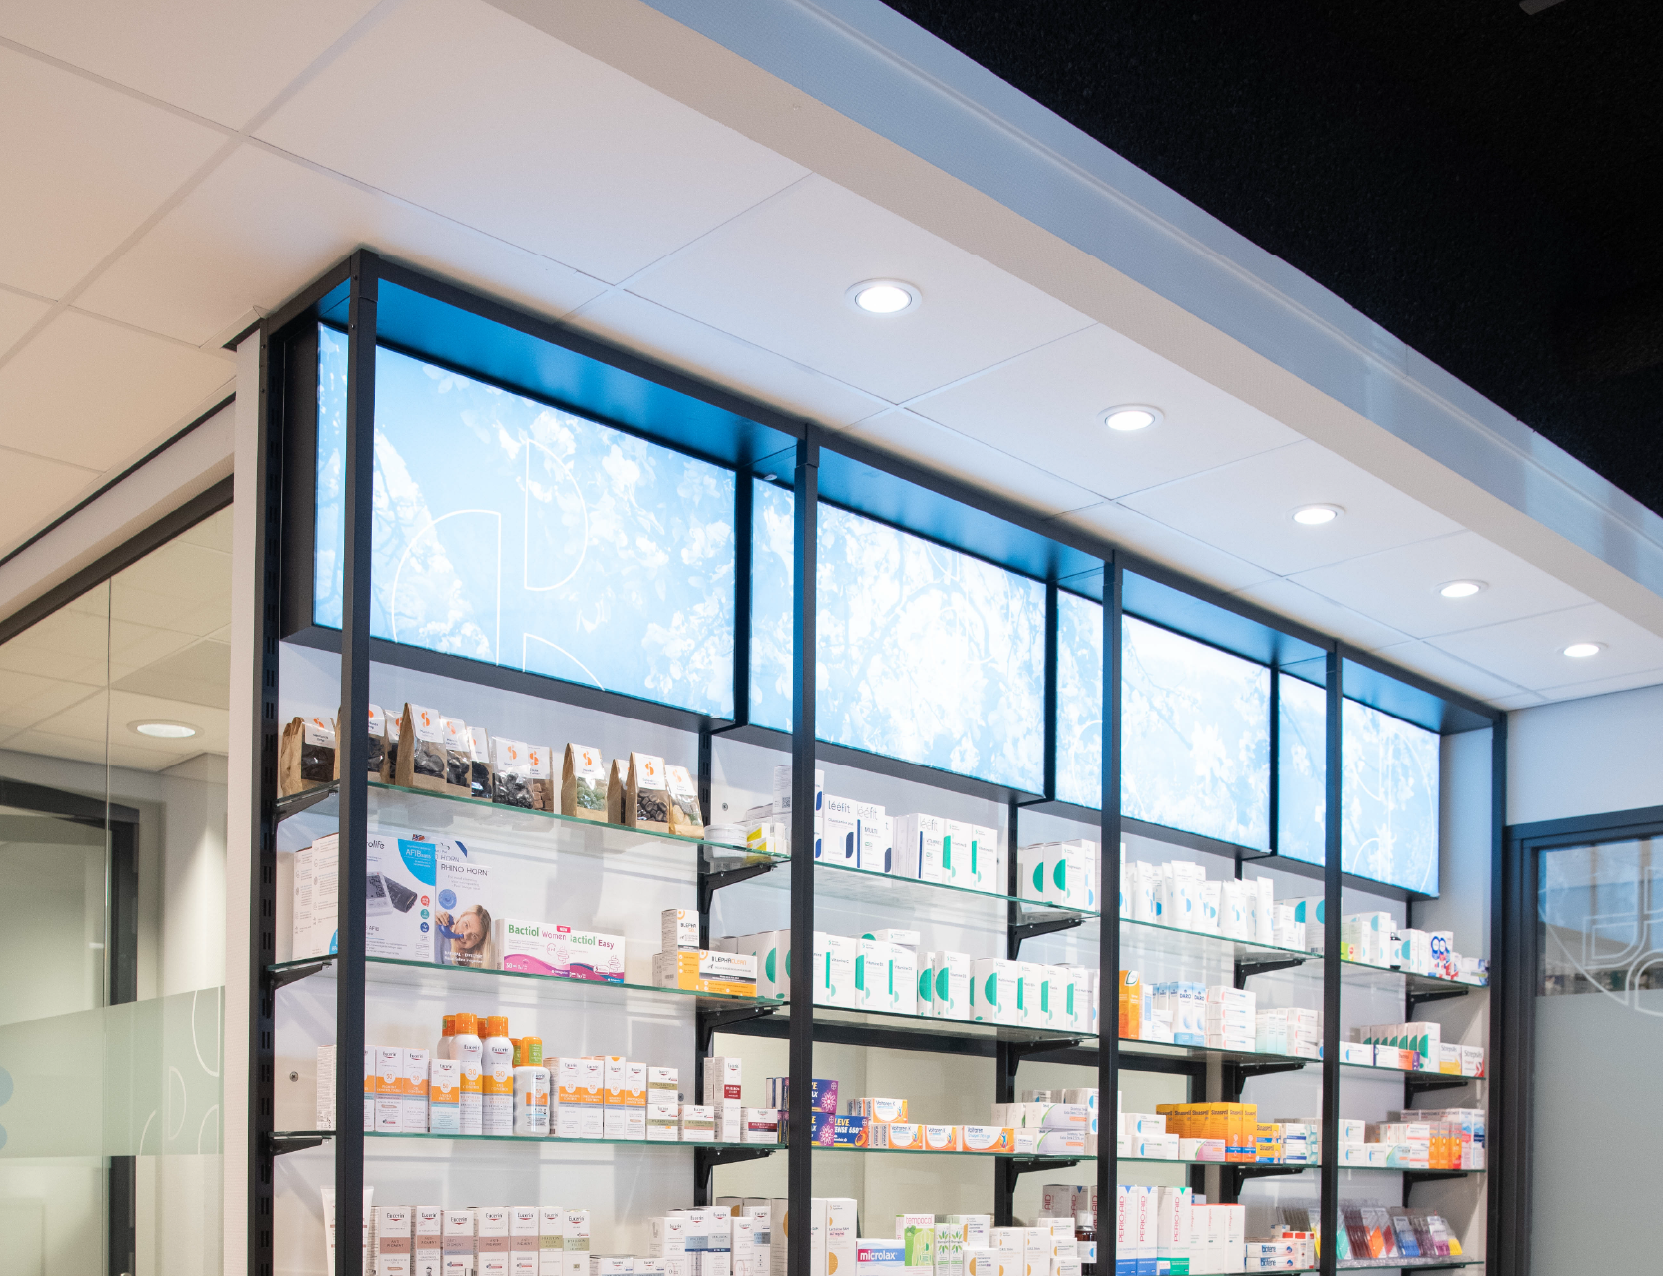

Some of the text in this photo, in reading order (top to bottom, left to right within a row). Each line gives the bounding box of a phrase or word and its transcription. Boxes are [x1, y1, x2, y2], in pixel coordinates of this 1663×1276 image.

[441, 863, 488, 877] RHINO HORN
[508, 924, 567, 941] Bactiol Women
[598, 939, 615, 950] Easy
[1464, 1049, 1483, 1059] Strepsils
[467, 1068, 477, 1076] 30
[834, 1119, 850, 1127] LEVE
[905, 1215, 933, 1226] tempocol
[859, 1250, 896, 1261] microlax
